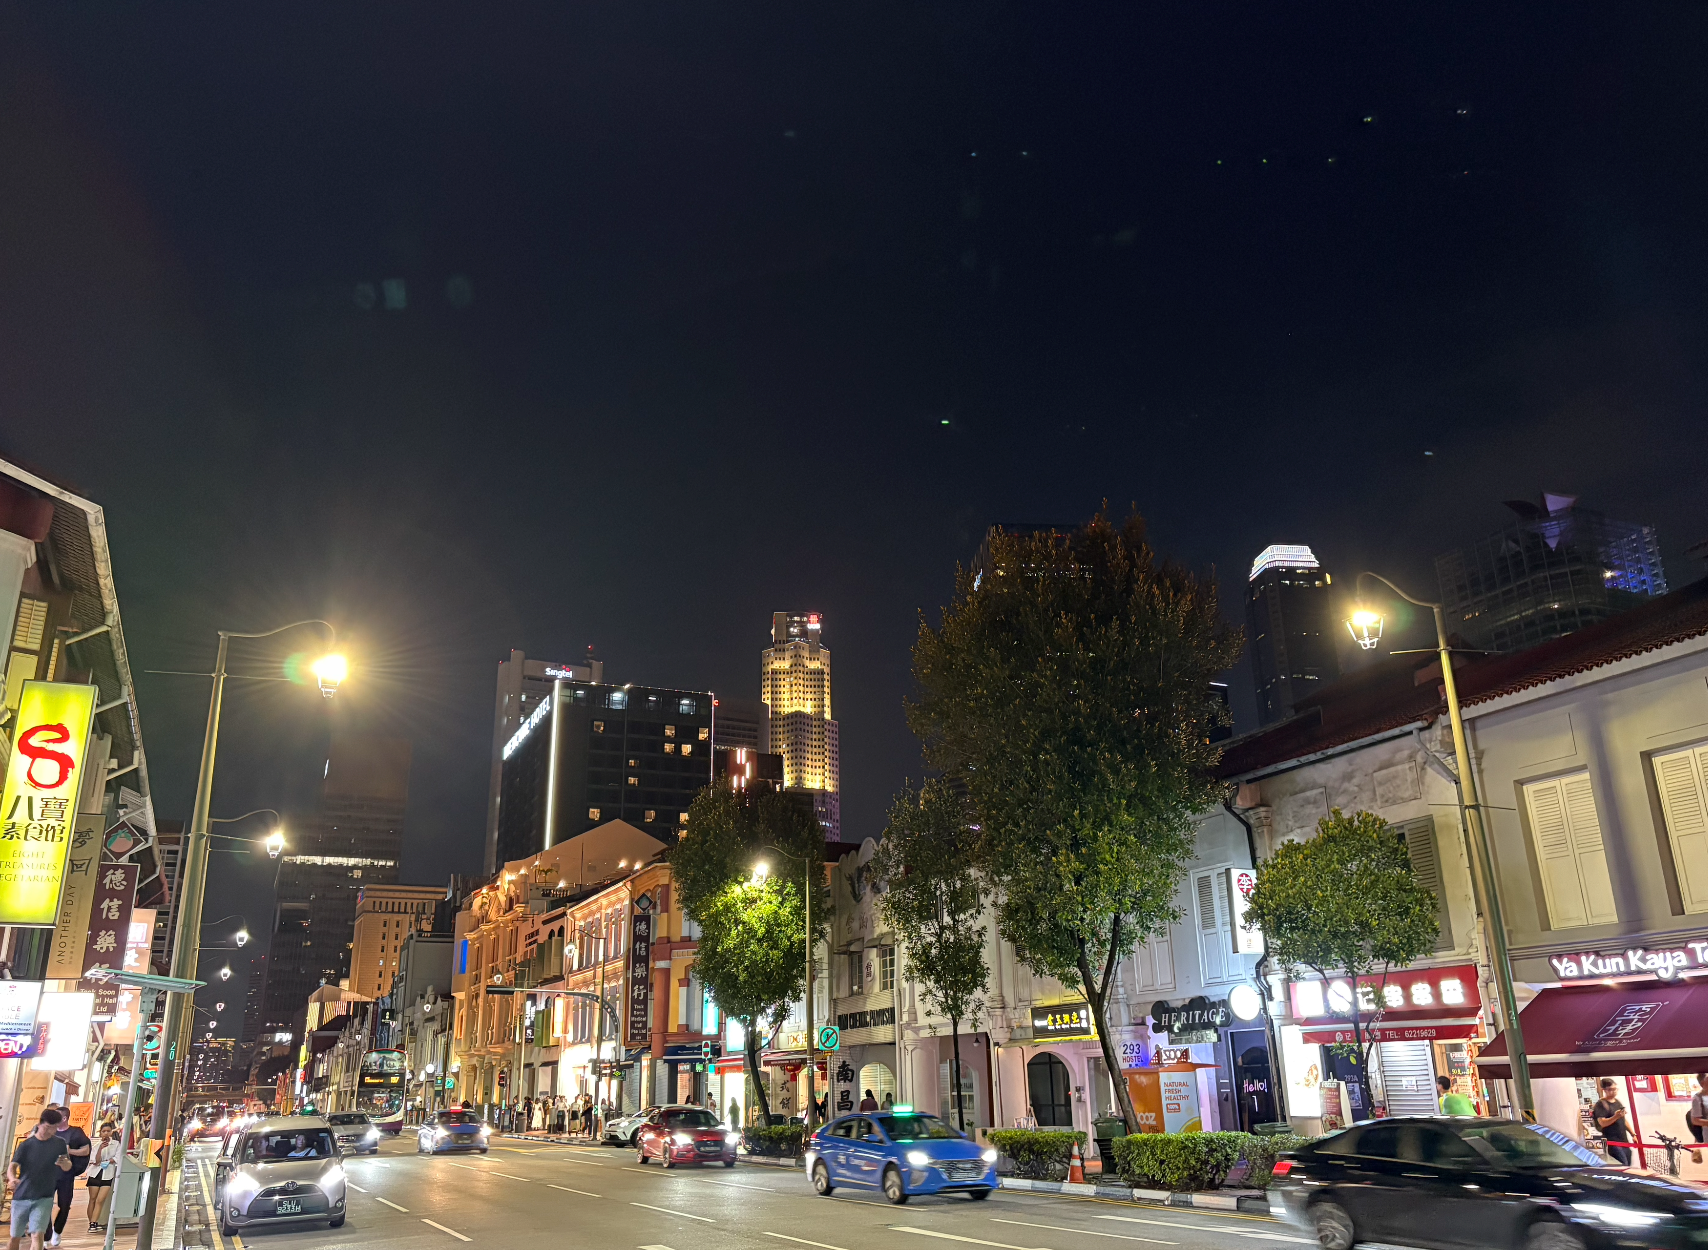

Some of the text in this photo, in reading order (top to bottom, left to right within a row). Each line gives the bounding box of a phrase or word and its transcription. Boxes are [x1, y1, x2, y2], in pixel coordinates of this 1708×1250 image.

[545, 667, 573, 678] Singtel
[530, 694, 551, 729] HOTEL
[12, 849, 46, 859] EIGHT
[0, 860, 58, 871] TREASURES
[56, 911, 73, 965] ANOTHER
[66, 884, 77, 906] DAY
[1551, 956, 1579, 978] Ya
[1580, 953, 1625, 976] Kun
[1627, 948, 1688, 980] Kaya
[97, 988, 116, 996] Soon
[1161, 1008, 1227, 1026] HERITAGE
[1384, 1030, 1401, 1039] TEL:
[1122, 1043, 1141, 1055] 293
[1122, 1055, 1145, 1063] HOSTEL
[836, 1060, 855, 1112] 南昌
[1243, 1078, 1268, 1094] Hello!
